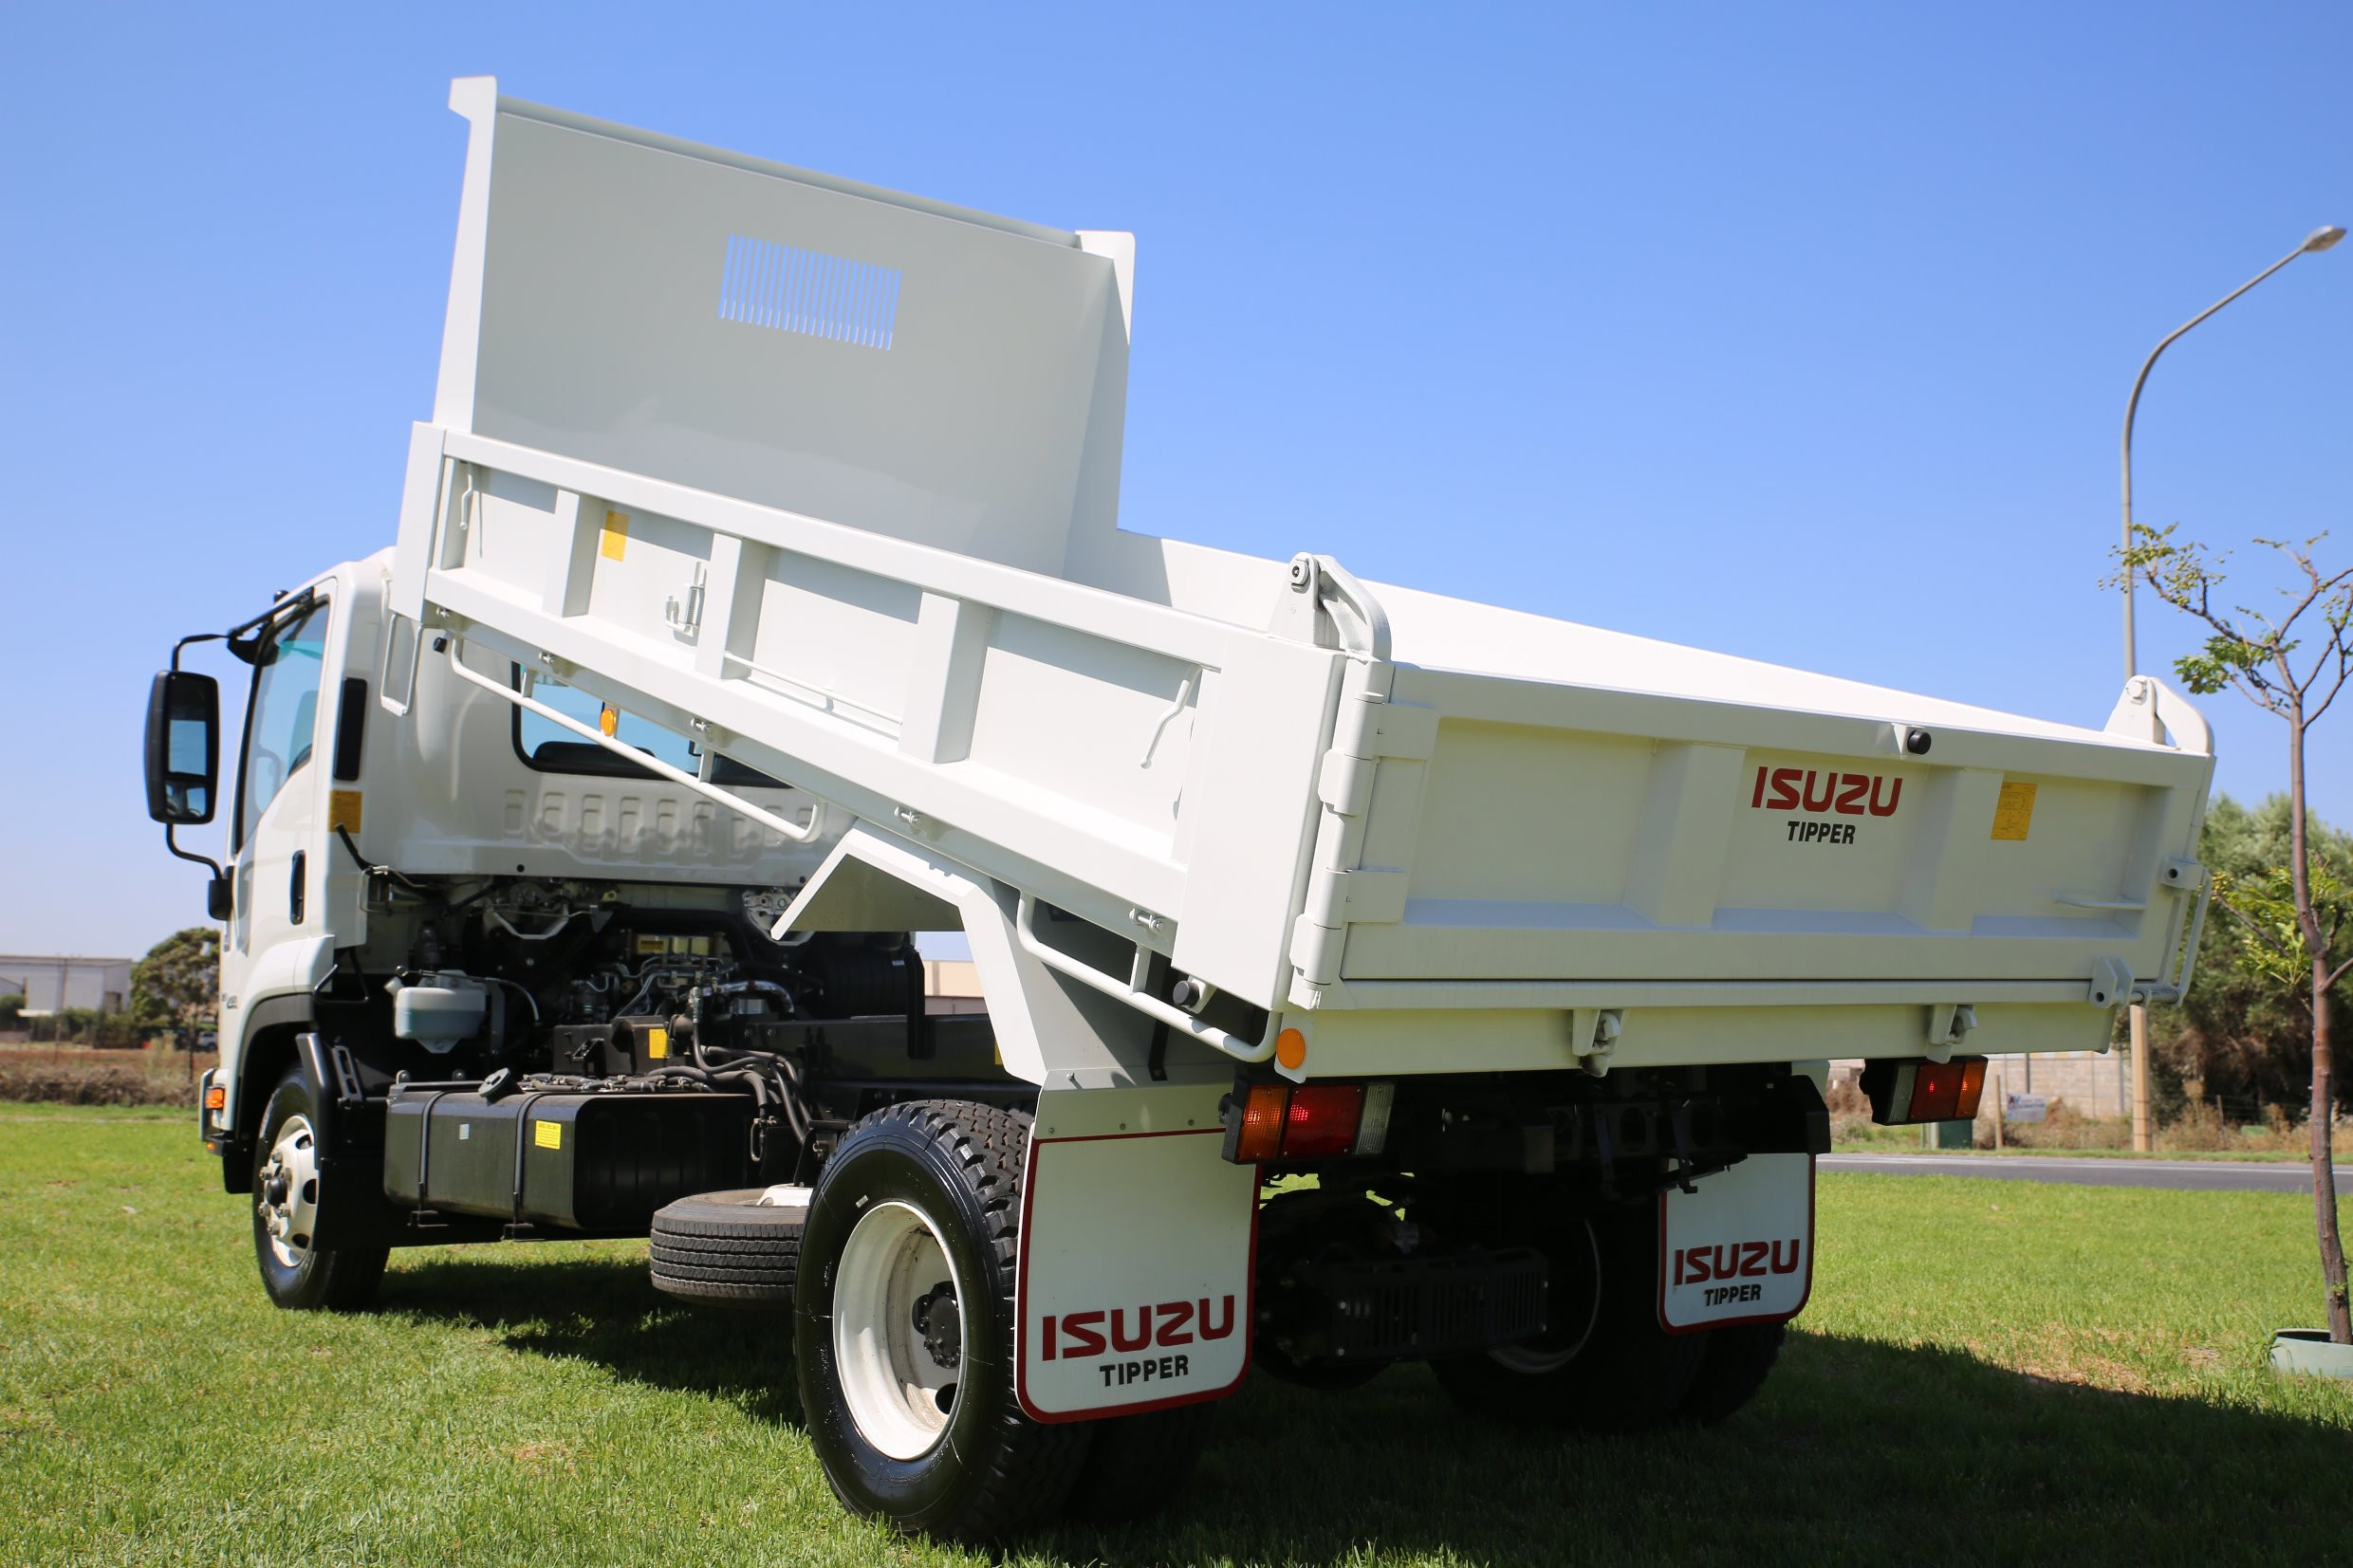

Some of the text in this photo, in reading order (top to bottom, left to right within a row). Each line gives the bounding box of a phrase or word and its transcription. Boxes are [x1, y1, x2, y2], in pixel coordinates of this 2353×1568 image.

[1751, 766, 1903, 817] ISUZU
[1788, 821, 1856, 844] TIPPER
[1674, 1239, 1800, 1285] ISUZU
[1704, 1283, 1761, 1306] TIPPER
[1042, 1295, 1235, 1361] ISUZU
[1100, 1355, 1189, 1387] TIPPER
